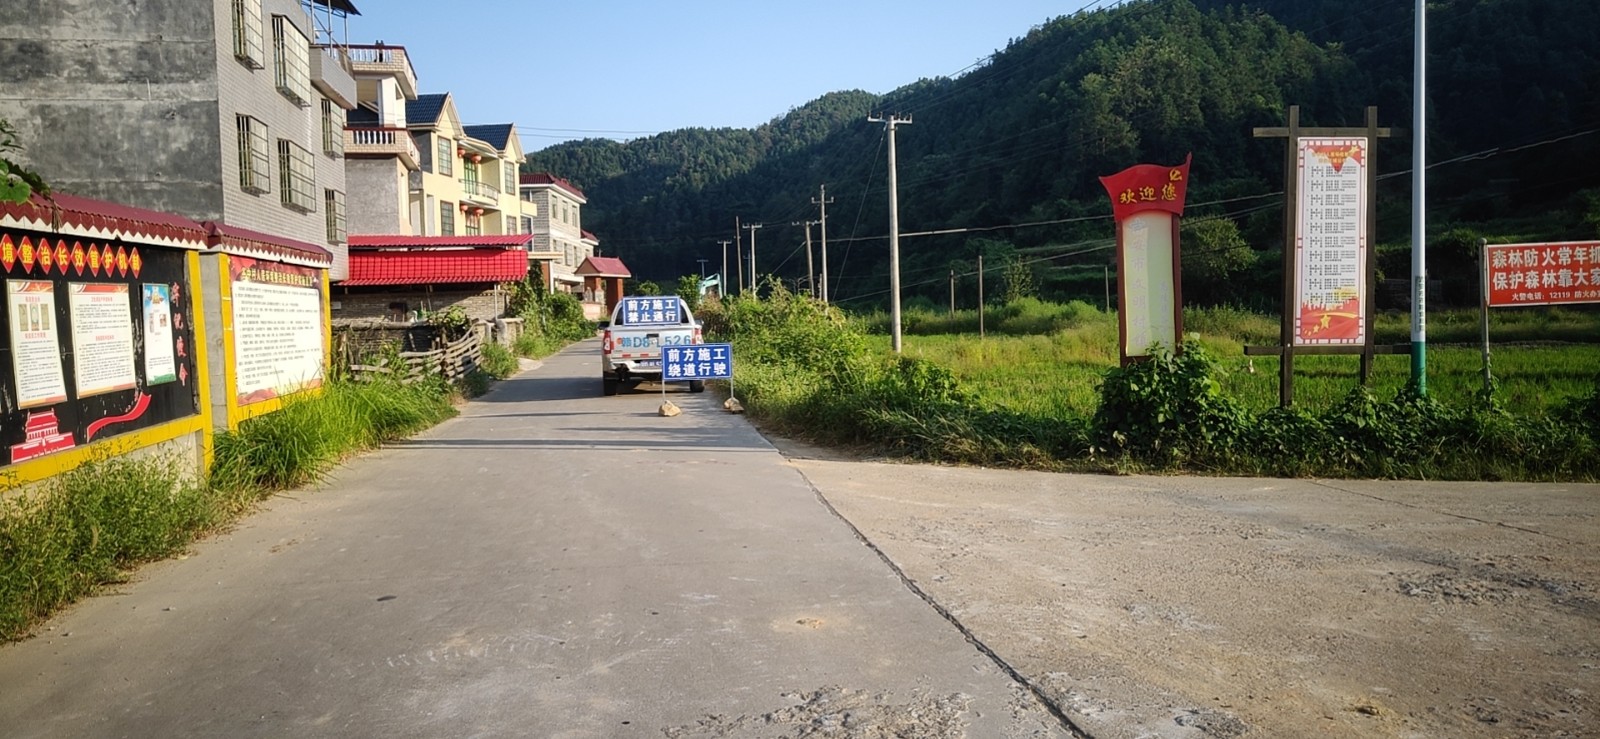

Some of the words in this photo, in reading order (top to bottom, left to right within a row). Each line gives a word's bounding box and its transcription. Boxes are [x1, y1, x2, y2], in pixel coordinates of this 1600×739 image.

[1120, 183, 1177, 204] 欢迎您
[1549, 291, 1571, 299] 12119
[627, 299, 676, 311] 前方施工
[627, 311, 676, 322] 禁止通行
[667, 348, 726, 362] 前方施工
[667, 362, 727, 376] 绕道行驶
